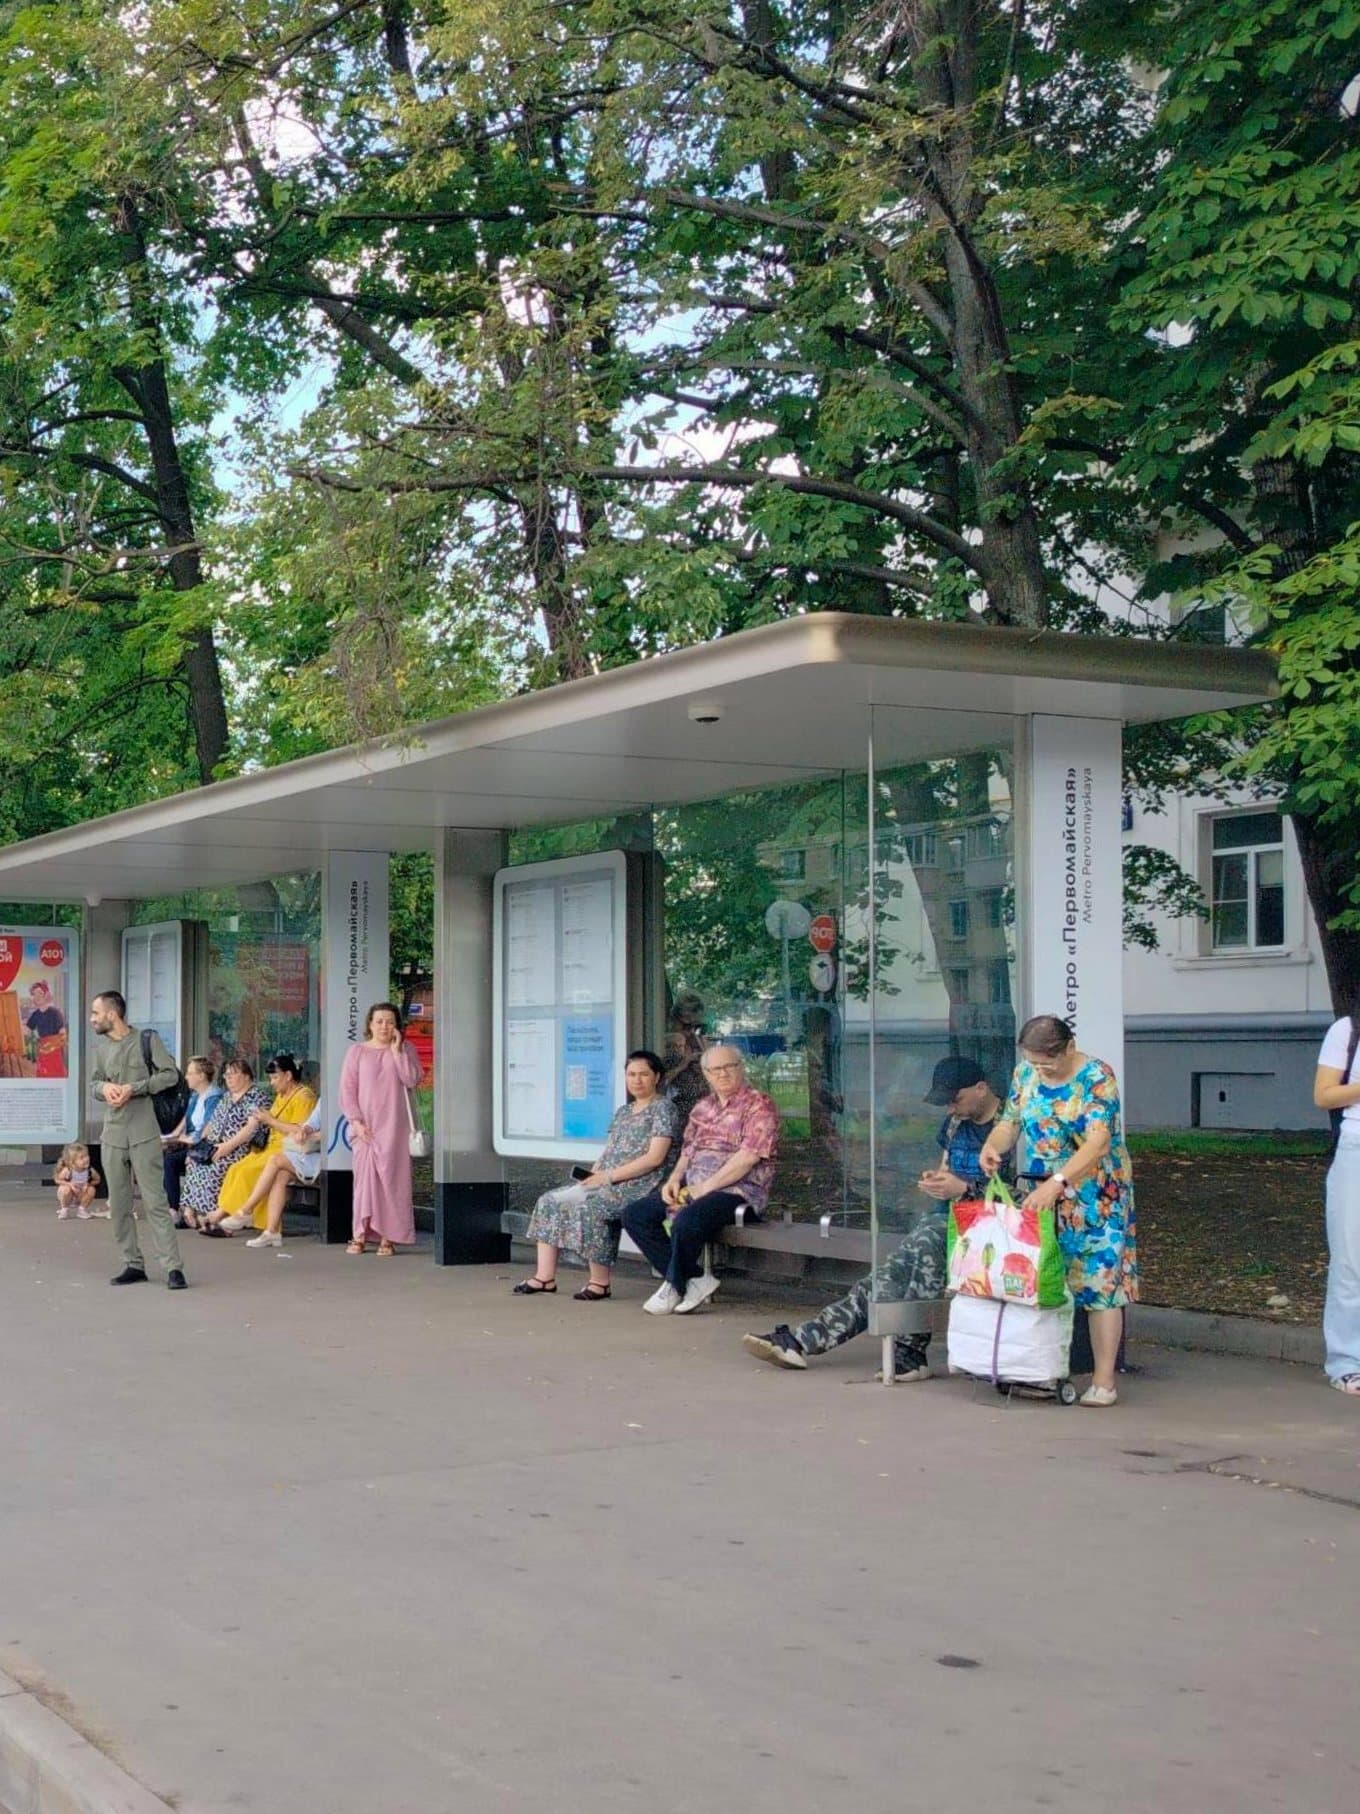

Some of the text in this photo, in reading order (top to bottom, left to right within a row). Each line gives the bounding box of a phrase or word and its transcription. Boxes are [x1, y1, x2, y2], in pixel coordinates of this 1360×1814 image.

[1062, 767, 1079, 956] «Первомайская»
[1082, 767, 1093, 924] Metro Pervomayskaya
[347, 880, 359, 1041] Метро «Первомайская»
